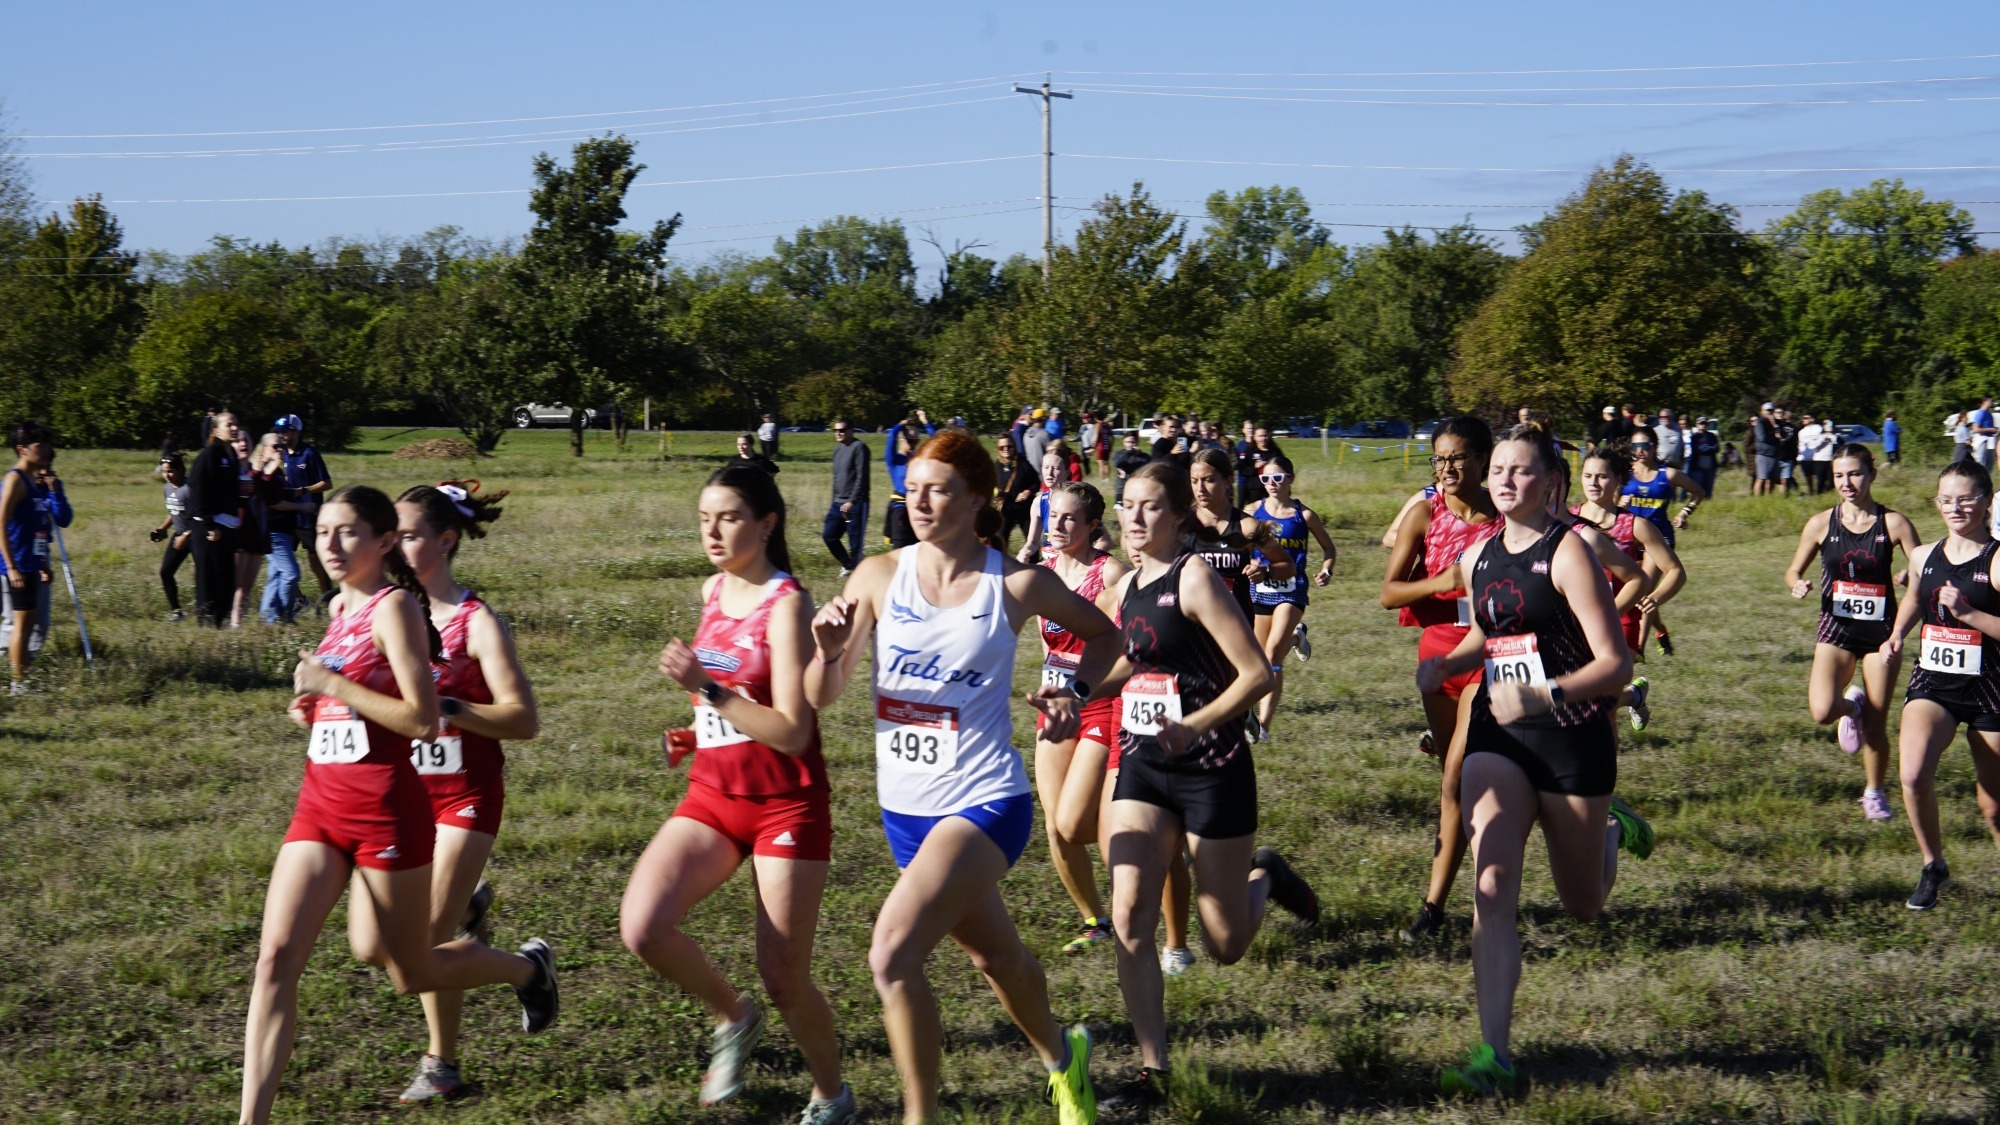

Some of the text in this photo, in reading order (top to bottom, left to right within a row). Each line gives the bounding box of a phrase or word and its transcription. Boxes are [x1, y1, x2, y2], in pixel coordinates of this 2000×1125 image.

[1199, 552, 1240, 568] STON
[1841, 598, 1875, 616] 459
[888, 644, 984, 688] Tabor
[1930, 646, 1966, 669] 461
[1494, 661, 1531, 687] 460
[707, 712, 742, 738] 51
[321, 729, 355, 755] 514
[413, 743, 446, 767] 19
[890, 731, 939, 765] 493
